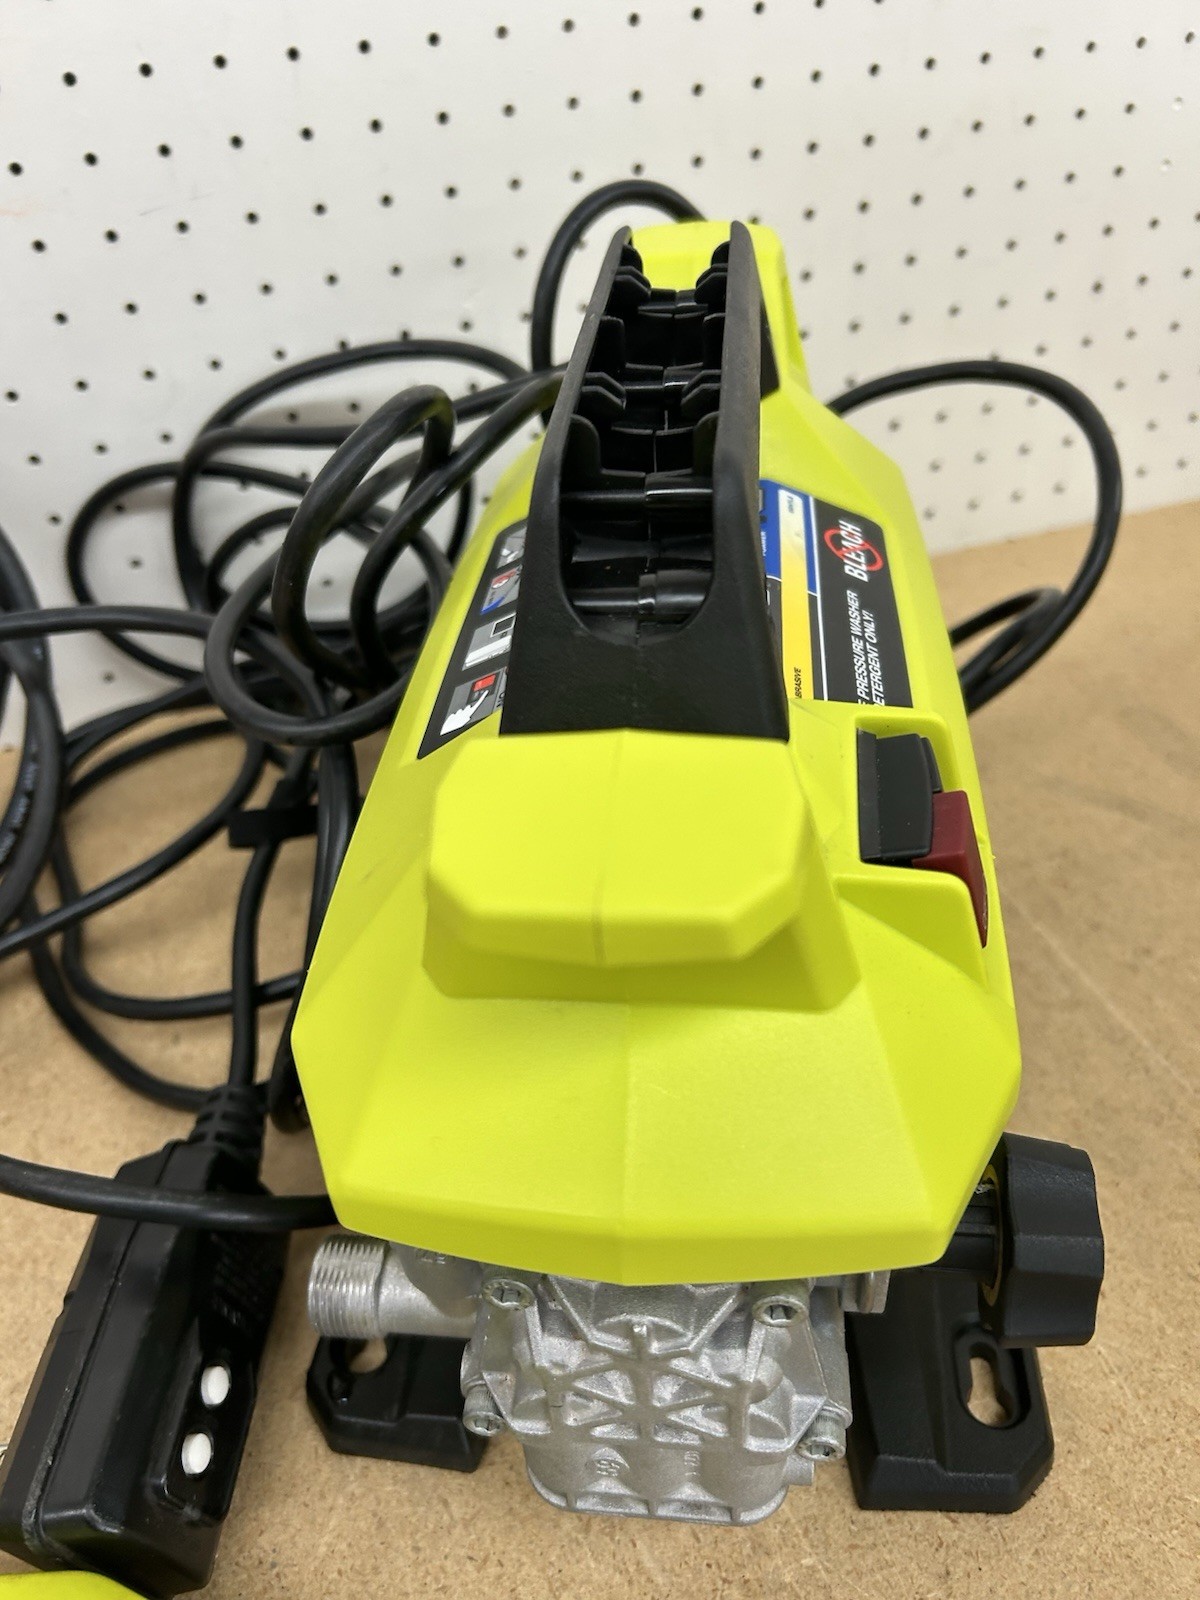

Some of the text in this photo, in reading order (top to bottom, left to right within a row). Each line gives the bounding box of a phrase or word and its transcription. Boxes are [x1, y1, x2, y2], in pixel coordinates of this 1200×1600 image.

[838, 519, 869, 583] BLEACH
[846, 589, 863, 637] WASHER
[851, 636, 870, 701] PRESSURE
[862, 610, 886, 707] ETERGENT ONLY!
